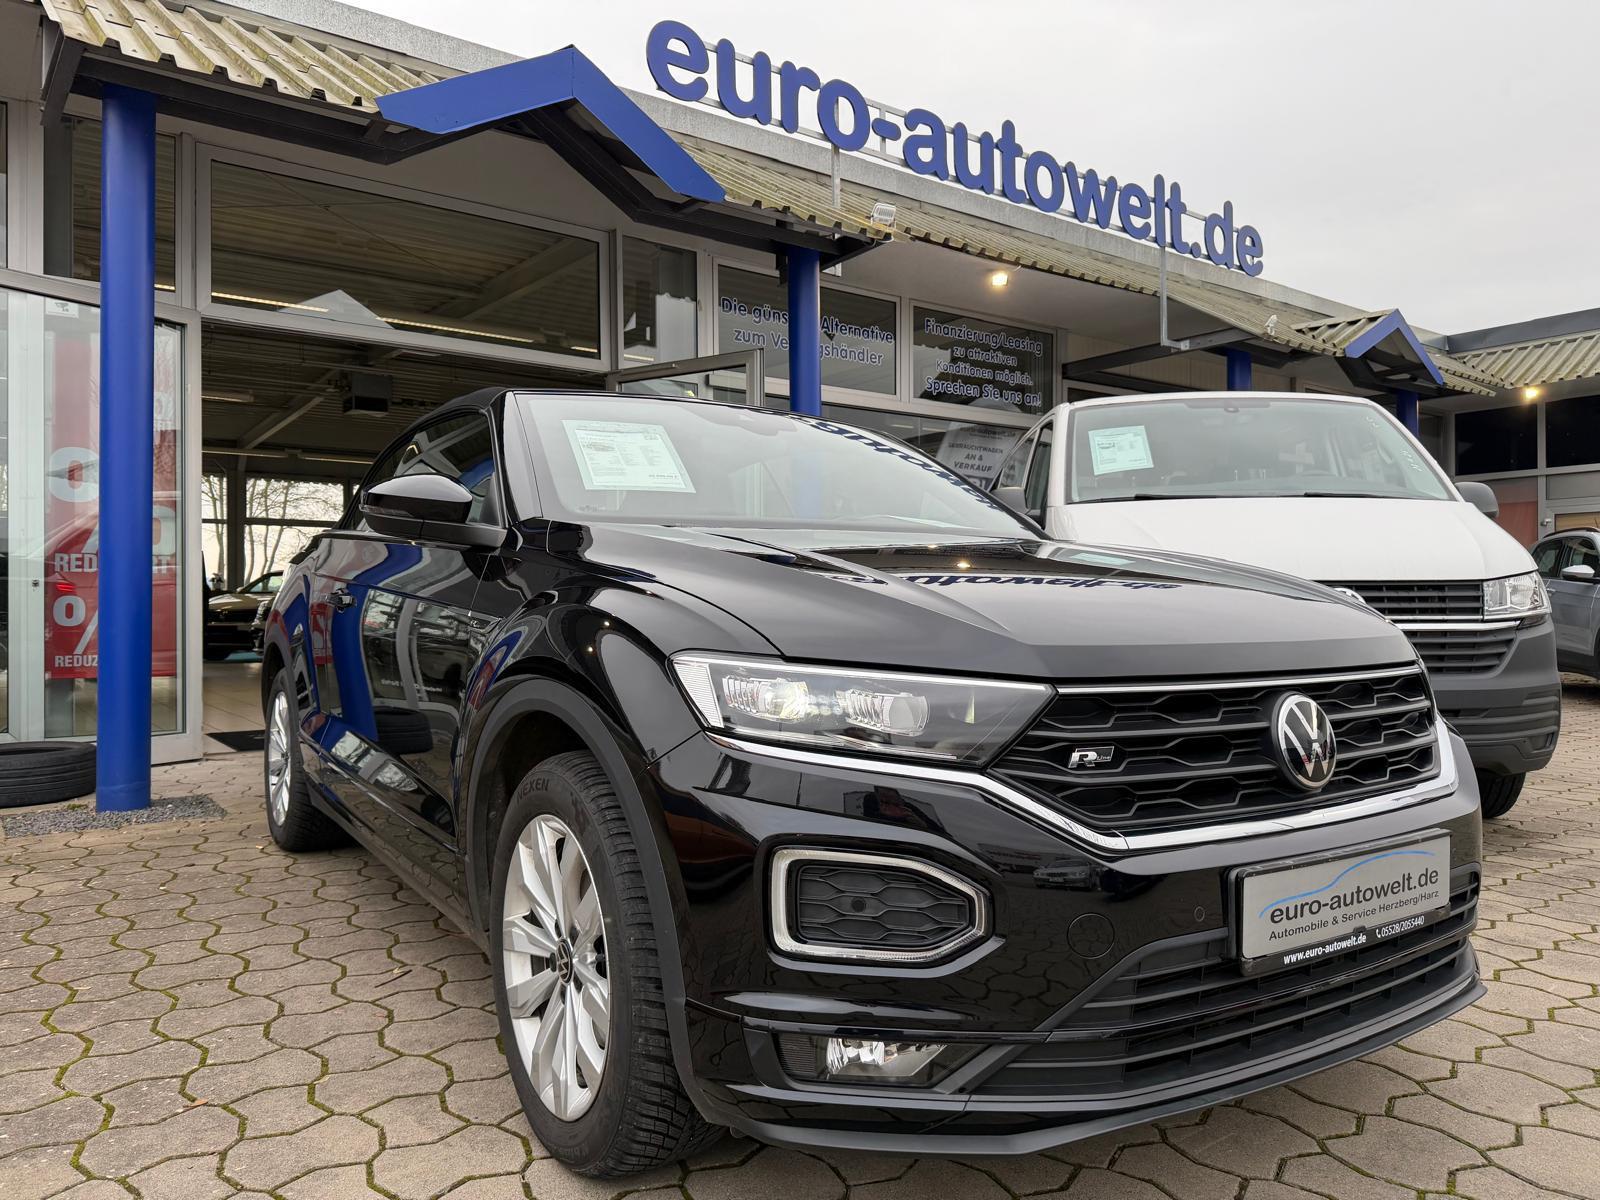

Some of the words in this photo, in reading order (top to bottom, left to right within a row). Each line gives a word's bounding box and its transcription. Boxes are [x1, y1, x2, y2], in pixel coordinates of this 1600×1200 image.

[646, 20, 1264, 278] euro-autowelt.de
[720, 297, 748, 317] Die
[752, 304, 789, 325] güns
[821, 315, 895, 344] Alternative
[924, 317, 1043, 356] Finanzierung/Leasing
[733, 328, 767, 347] zum
[771, 331, 885, 366] Vegshändler
[952, 346, 966, 358] zu
[967, 348, 1018, 367] attraktiven
[925, 375, 980, 396] Sprechen
[981, 383, 1000, 400] Sie
[1002, 390, 1022, 404] uns
[1023, 391, 1042, 408] an!
[935, 359, 994, 381] Konditionen
[994, 370, 1034, 387] möglich.
[953, 461, 993, 473] VERKAUF
[54, 654, 99, 668] REDUZ
[516, 777, 550, 805] NEXEN
[1270, 868, 1439, 924] euro-autowelt.de
[1268, 919, 1330, 942] Automobile
[1331, 916, 1340, 926] &
[1341, 906, 1378, 923] Service
[1378, 889, 1440, 914] Herzberg/Harz
[1283, 933, 1367, 965] www.euro-autowelt.de
[1380, 915, 1425, 937] 05528/2065440
